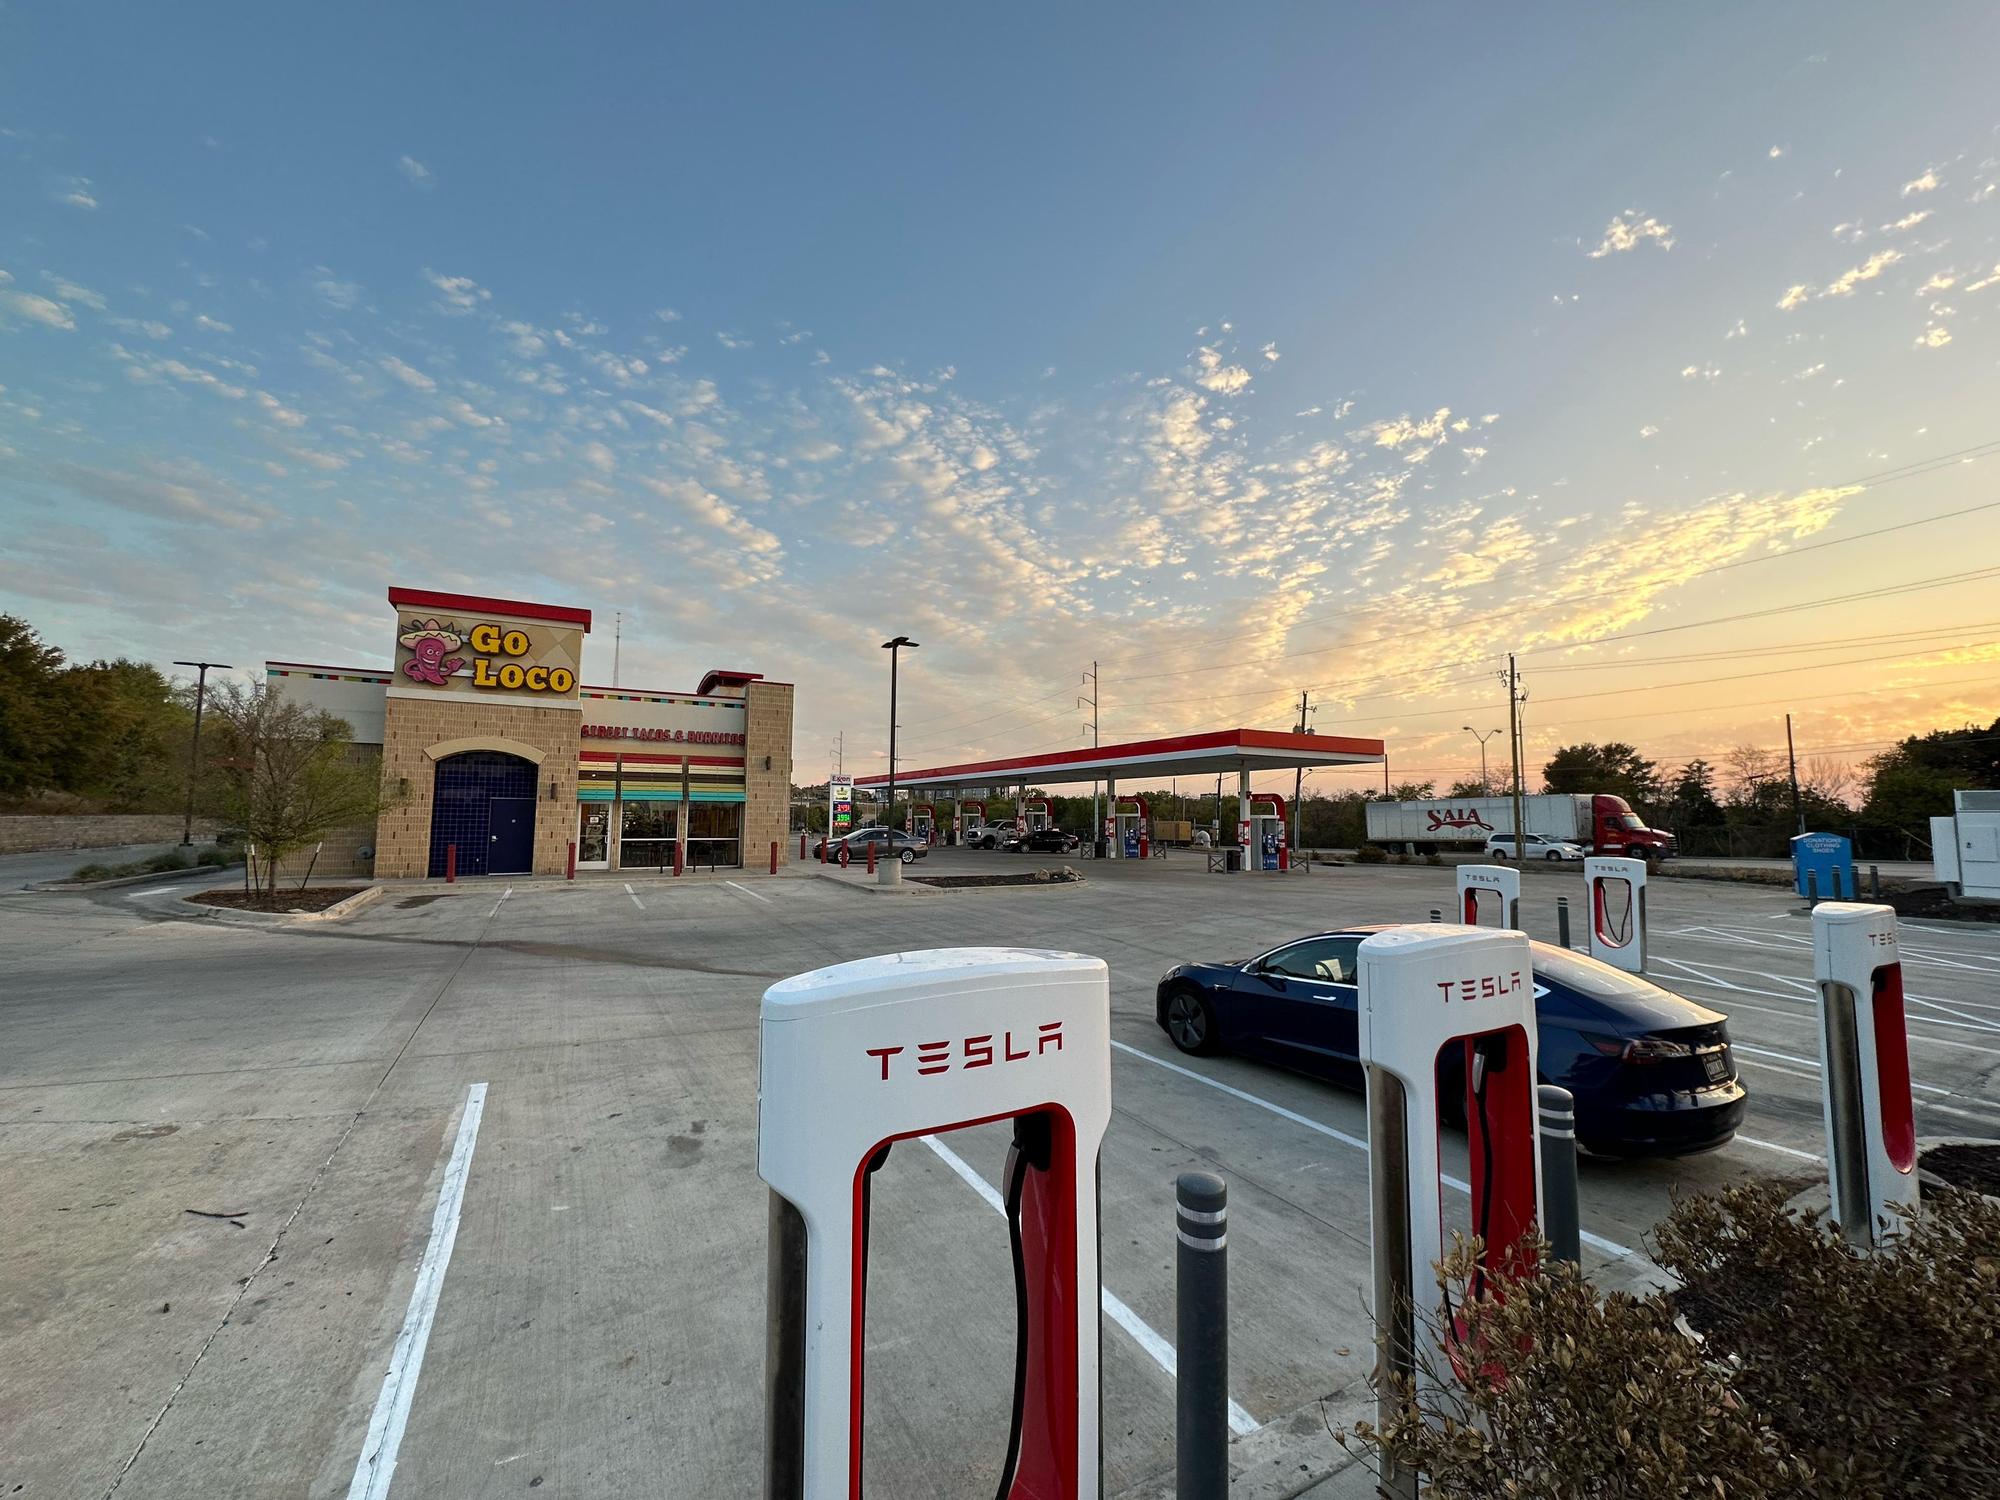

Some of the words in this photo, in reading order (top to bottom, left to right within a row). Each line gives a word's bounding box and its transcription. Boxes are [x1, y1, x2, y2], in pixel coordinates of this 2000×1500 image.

[470, 623, 532, 657] GO
[473, 658, 576, 693] LOCO
[581, 725, 628, 739] STREET
[632, 728, 671, 742] TACOS
[674, 730, 684, 743] &
[687, 731, 745, 746] BURRITOS
[1427, 808, 1486, 831] SAIA
[1465, 874, 1500, 883] TESLA
[1436, 971, 1521, 1003] TESLA
[866, 1021, 1063, 1081] TESLA
